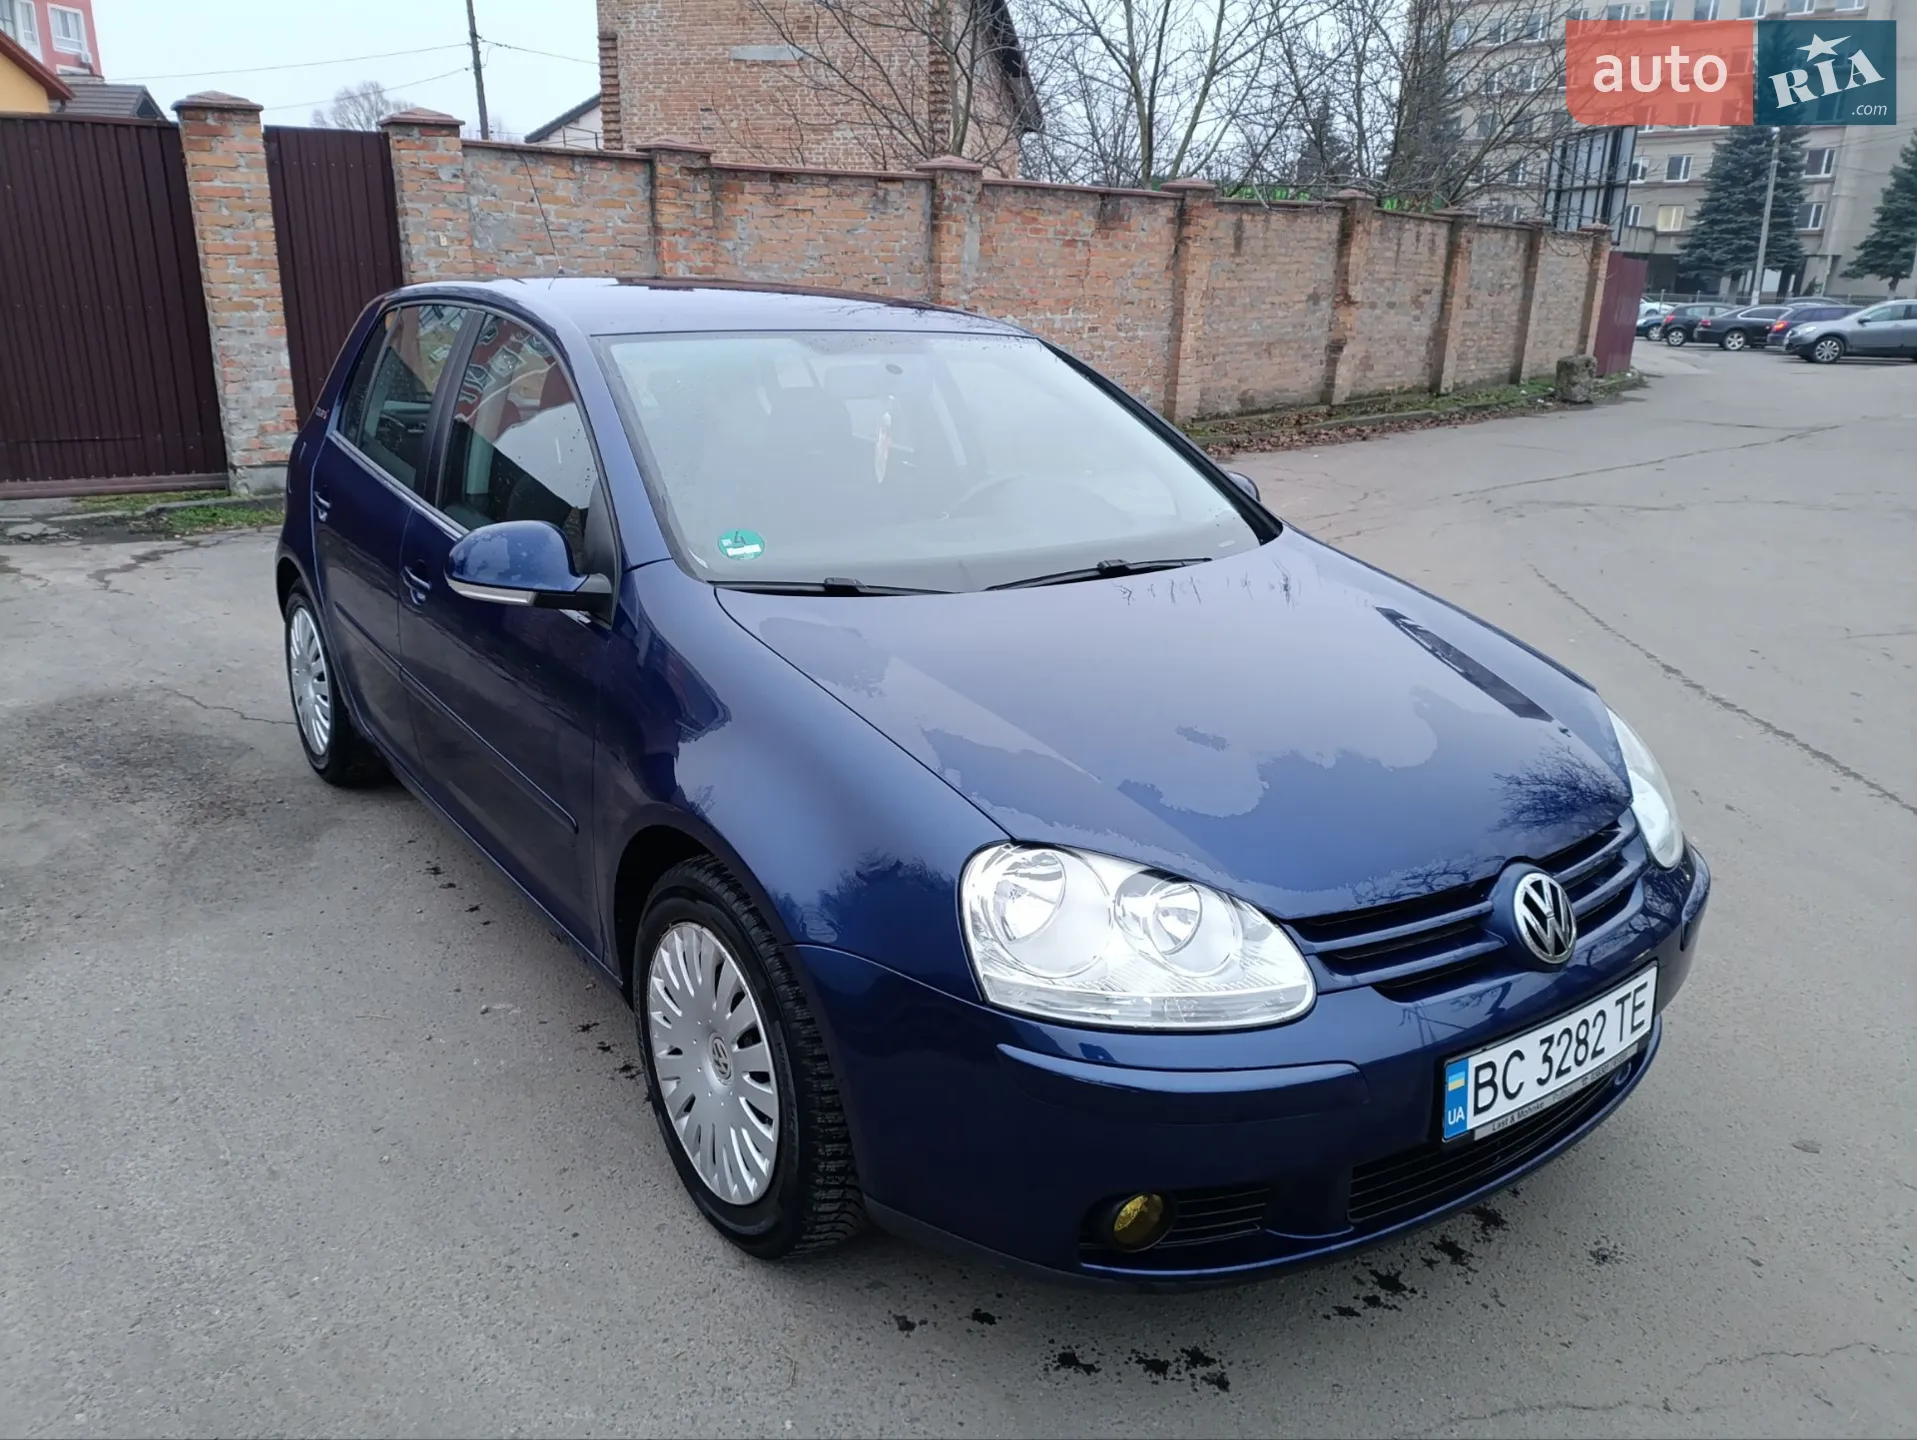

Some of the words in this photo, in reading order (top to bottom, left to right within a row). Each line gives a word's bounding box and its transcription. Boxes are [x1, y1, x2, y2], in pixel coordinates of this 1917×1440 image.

[1473, 1050, 1525, 1117] BC
[1536, 1009, 1606, 1086] 3282
[1615, 981, 1648, 1043] TE
[1448, 1110, 1465, 1125] UA
